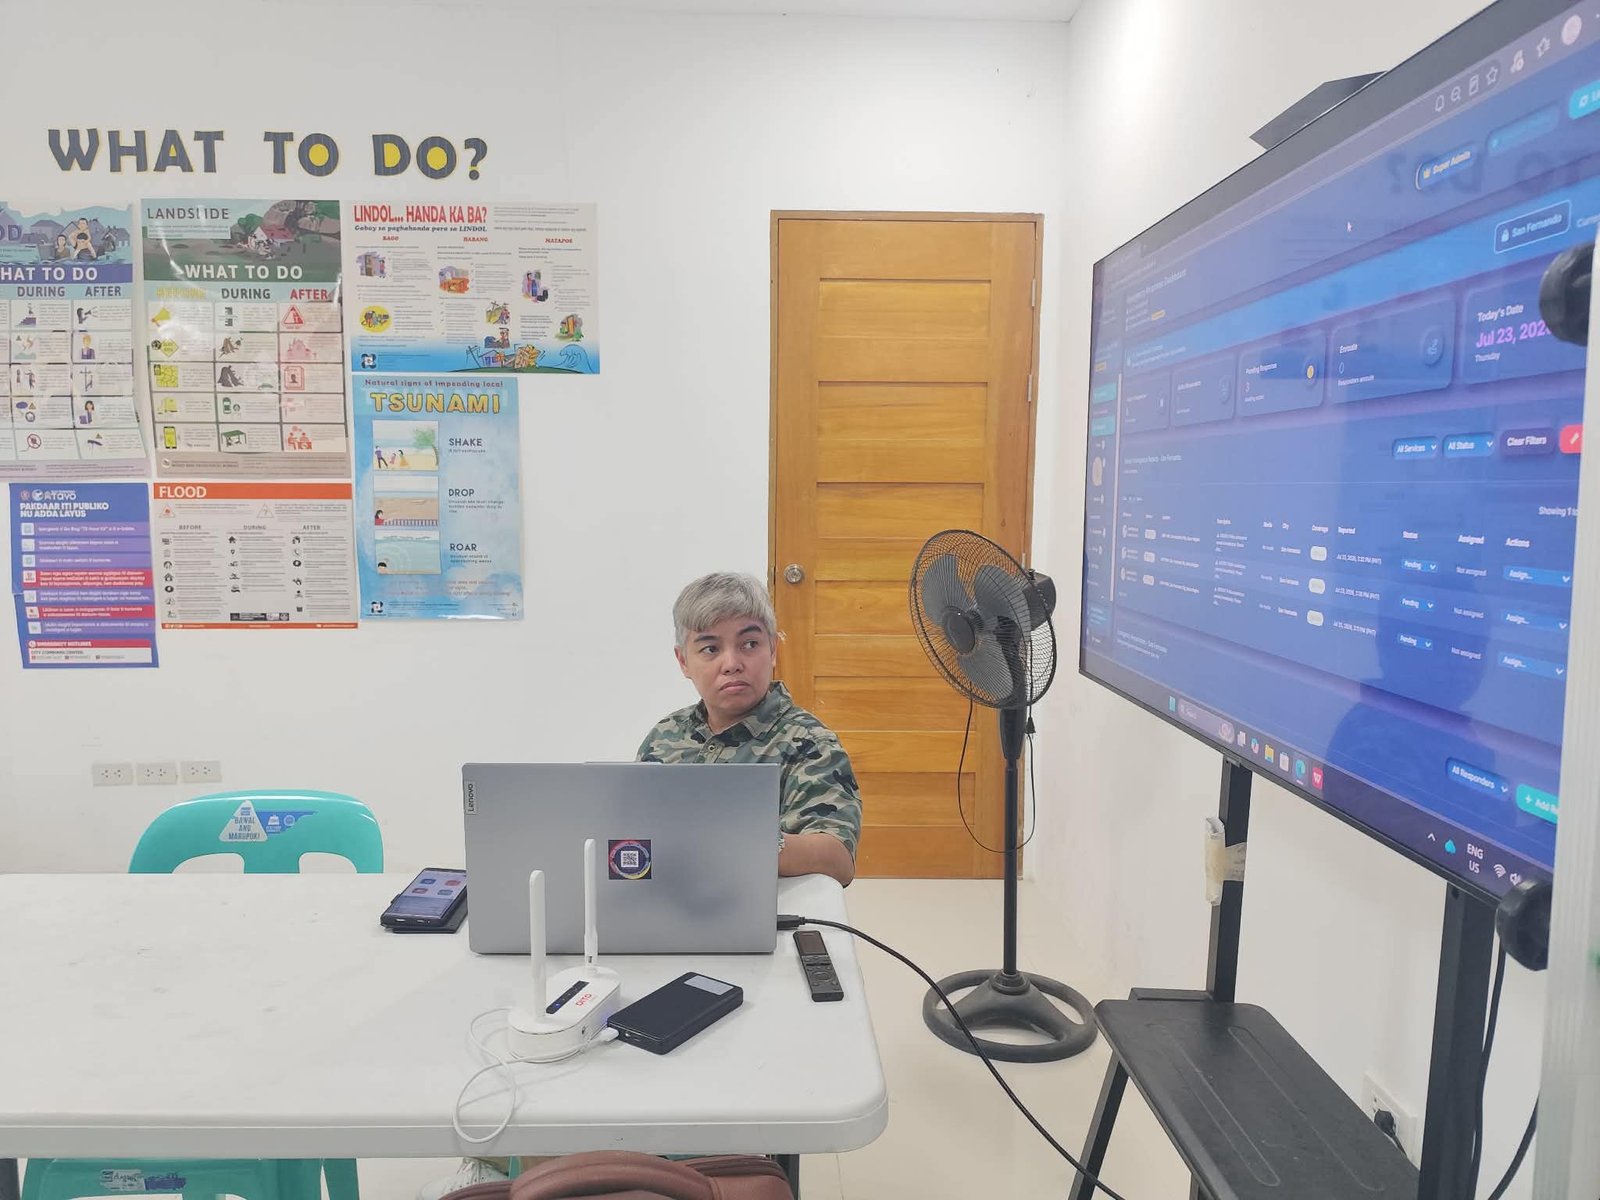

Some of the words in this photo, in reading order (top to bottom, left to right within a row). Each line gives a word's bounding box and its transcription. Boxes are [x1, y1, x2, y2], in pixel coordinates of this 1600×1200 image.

[48, 128, 224, 173] WHAT
[263, 131, 339, 176] TO
[371, 134, 488, 180] DO?
[354, 205, 404, 222] LINDOL...
[406, 205, 446, 223] HANDA
[449, 205, 465, 223] KA
[467, 205, 487, 224] BA?
[1512, 226, 1526, 238] San
[1526, 214, 1562, 233] Fernando
[42, 267, 65, 281] TO
[72, 267, 98, 281] DO
[185, 264, 238, 279] WHAT
[244, 265, 269, 279] TO
[277, 265, 303, 280] DO
[17, 286, 65, 297] DURING
[85, 286, 121, 297] AFTER
[221, 288, 271, 300] DURING
[290, 288, 328, 300] AFTER
[1477, 308, 1505, 322] Today's
[1506, 304, 1524, 316] Date
[1476, 331, 1495, 348] Jul
[1496, 326, 1516, 344] 23,
[1338, 362, 1345, 374] 0
[435, 380, 480, 388] impending
[370, 392, 501, 414] TSUNAMI
[448, 438, 482, 447] SHAKE
[1507, 437, 1525, 447] Clear
[159, 485, 207, 498] FLOOD
[448, 488, 475, 497] DROP
[1538, 506, 1567, 517] Showing
[449, 543, 477, 551] ROAR
[1505, 537, 1530, 548] Actions
[1460, 768, 1495, 789] Responders
[1467, 843, 1484, 860] ENG
[1468, 860, 1480, 874] US
